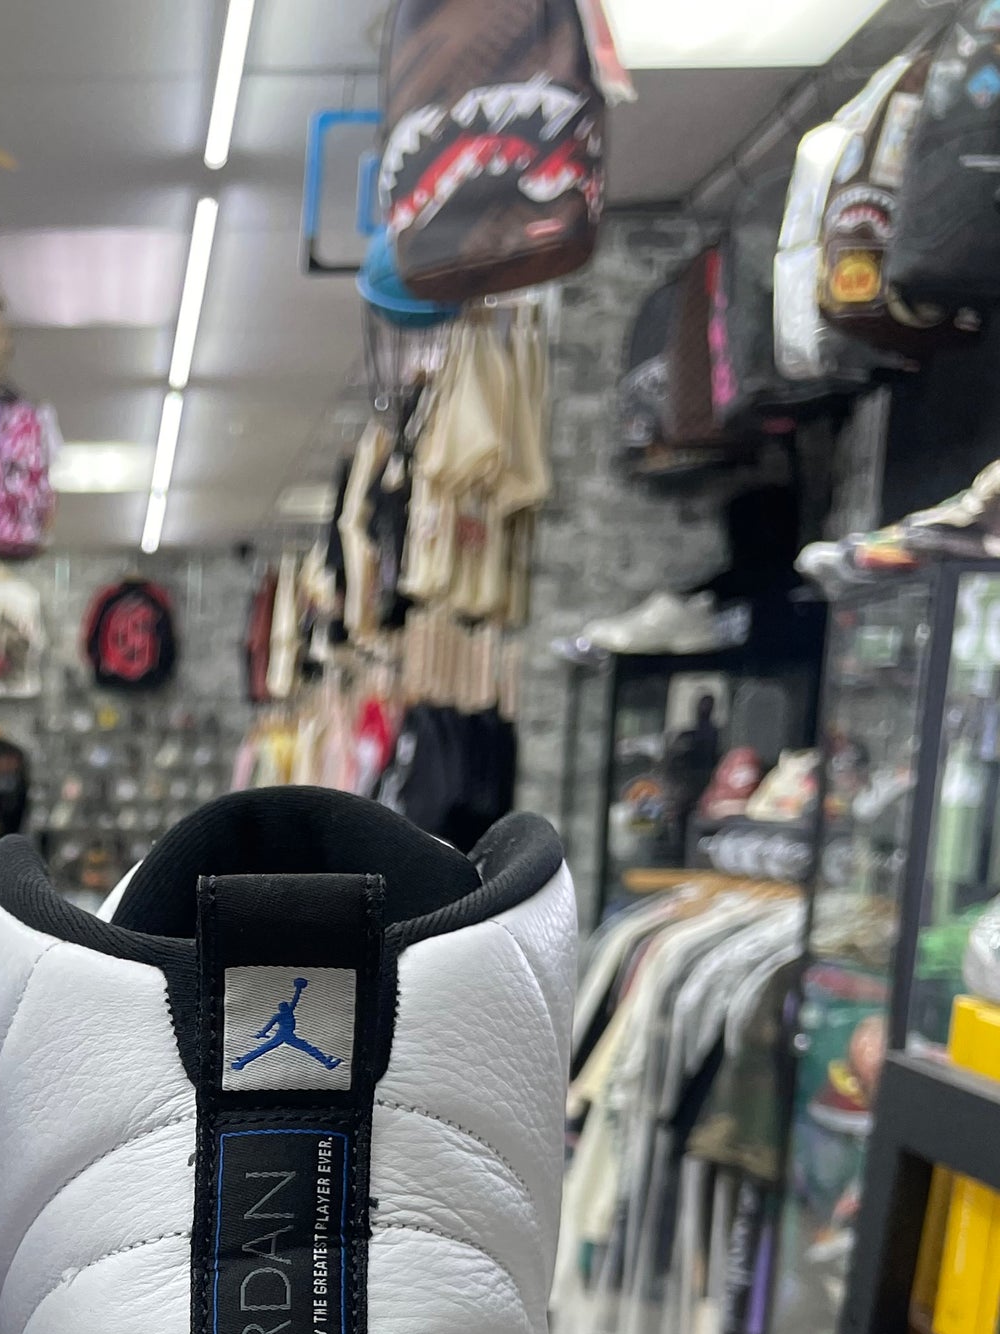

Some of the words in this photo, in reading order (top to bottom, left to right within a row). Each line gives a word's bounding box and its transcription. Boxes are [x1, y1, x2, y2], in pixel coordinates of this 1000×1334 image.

[317, 1136, 333, 1173] EVER.
[314, 1177, 331, 1230] PLAYER
[313, 1233, 329, 1295] GREATEST
[313, 1299, 328, 1323] THE
